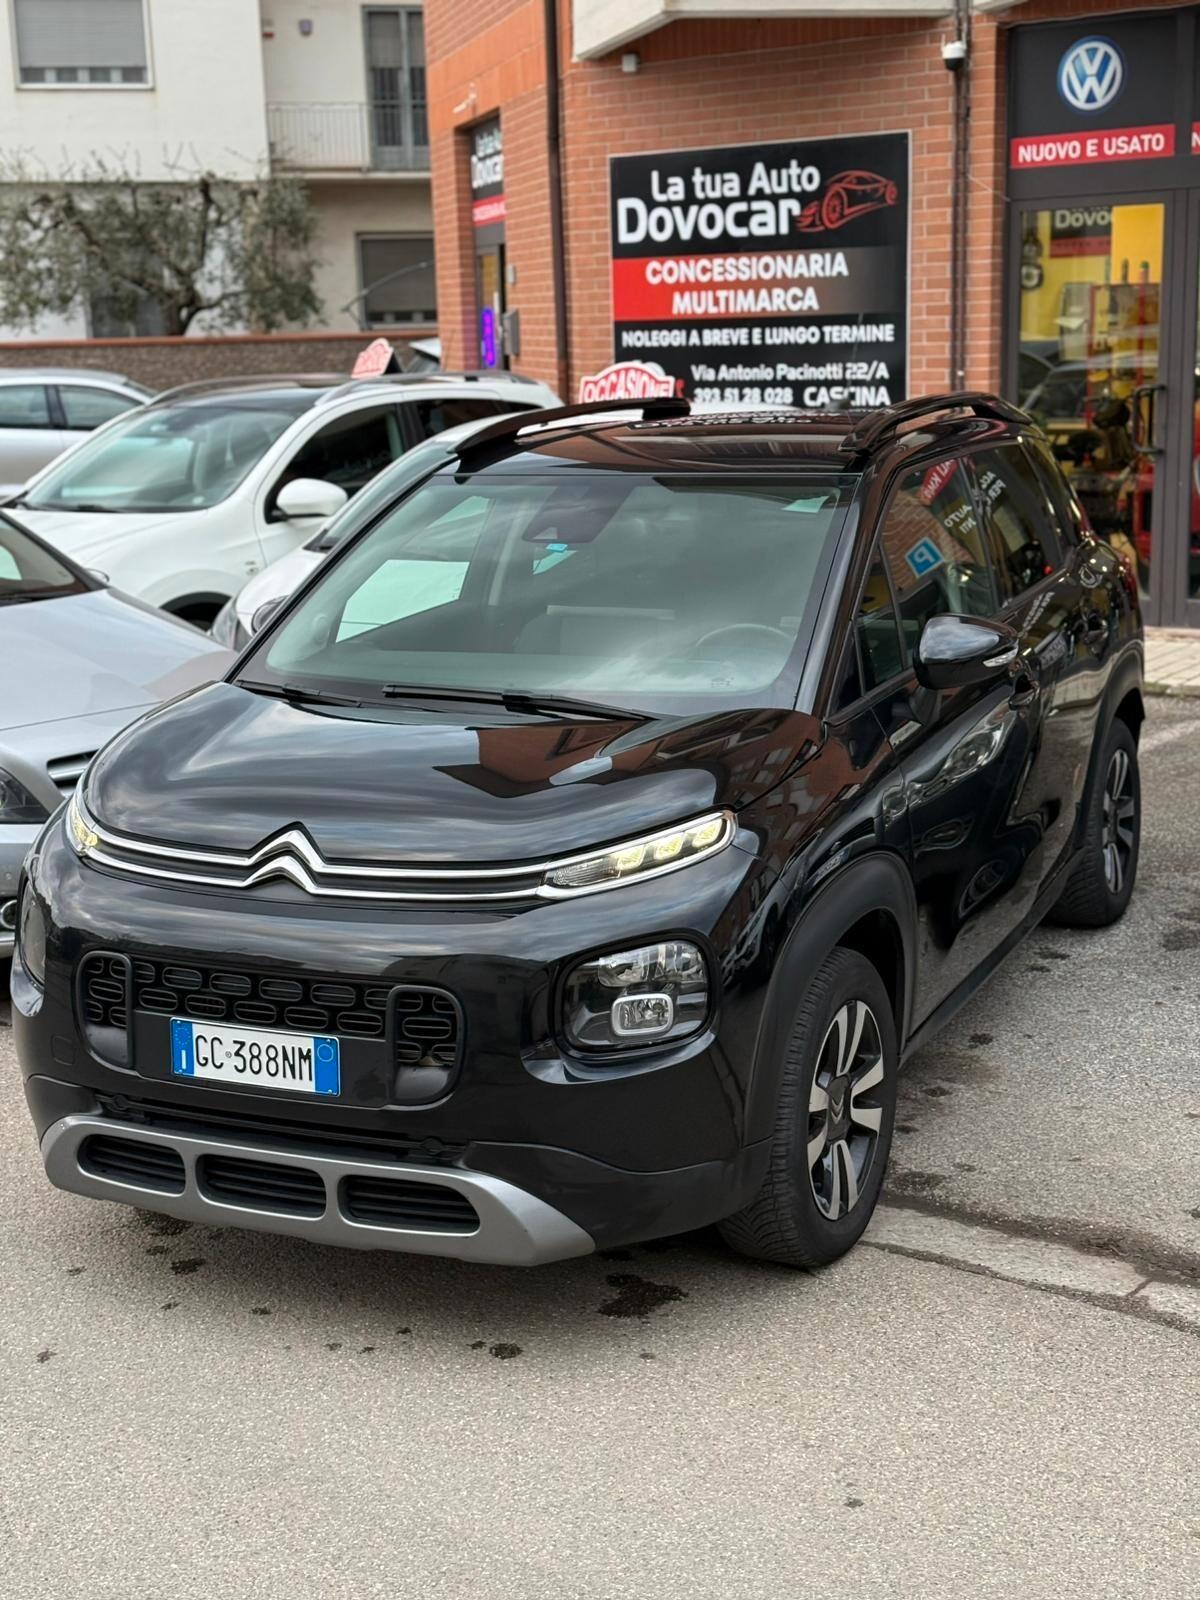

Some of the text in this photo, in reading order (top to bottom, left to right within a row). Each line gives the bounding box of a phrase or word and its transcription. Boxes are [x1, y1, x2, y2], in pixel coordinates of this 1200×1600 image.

[1018, 133, 1165, 163] NUOVO E USATO
[651, 159, 820, 202] La tua Auto
[617, 197, 800, 244] Dovocar
[645, 252, 849, 285] CONCESSIONARIA
[672, 286, 819, 315] MULTIMARCA
[621, 323, 895, 348] NOLEGGI A BREVE E LUNGO TERMINE
[690, 359, 890, 382] Via Antonio Pacinotti 22/A
[693, 386, 721, 404] 393
[764, 386, 793, 404] 028
